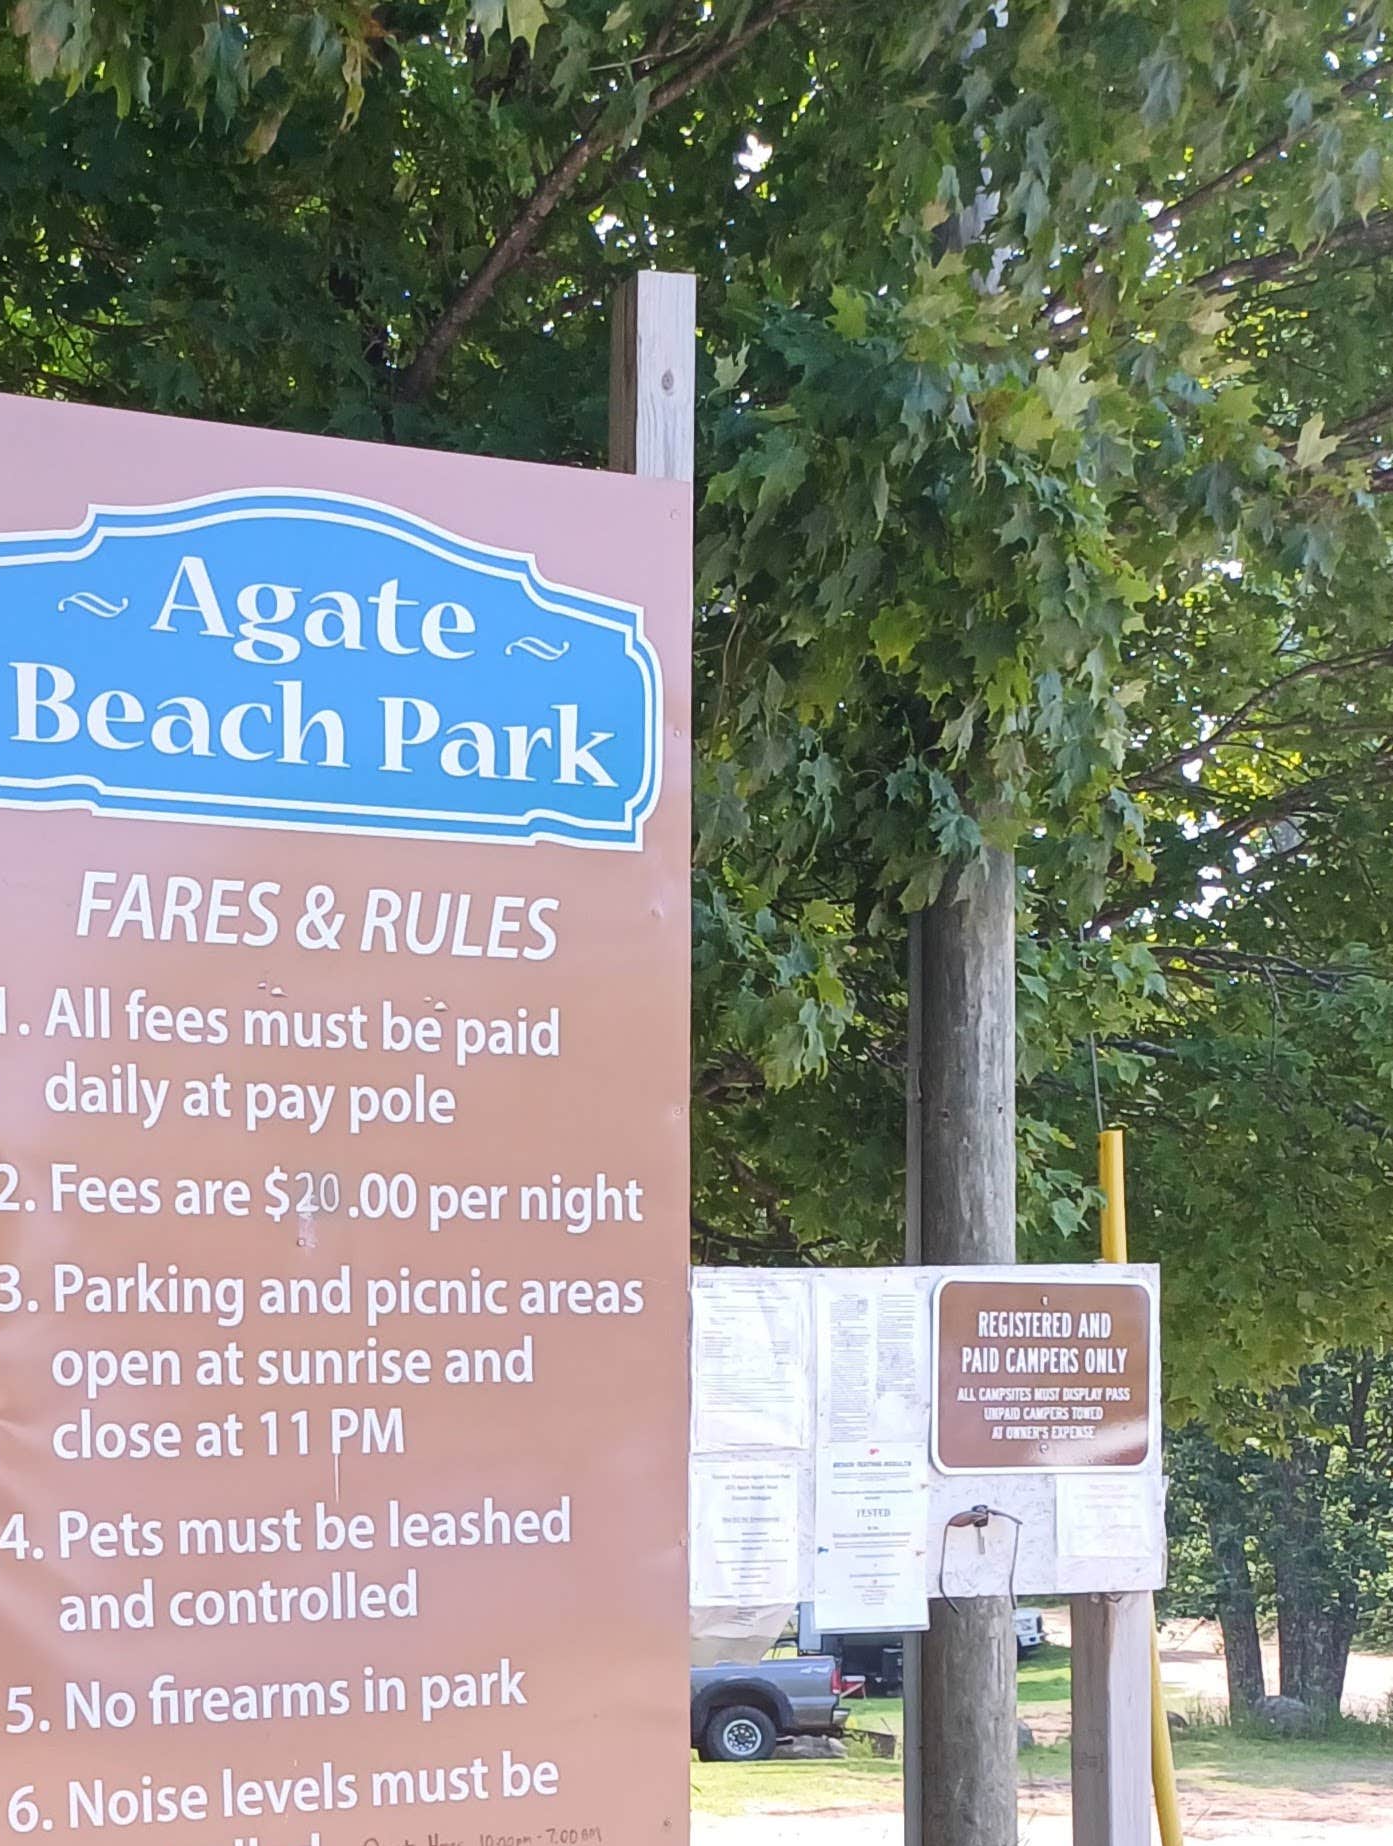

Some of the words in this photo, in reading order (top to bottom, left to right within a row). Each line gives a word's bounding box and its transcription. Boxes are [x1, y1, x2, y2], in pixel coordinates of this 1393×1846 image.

[153, 555, 476, 661] Agate
[9, 662, 350, 768] Beach
[378, 696, 618, 787] Park
[76, 871, 281, 947] FARES
[295, 884, 343, 950] &
[360, 888, 560, 961] RULES
[44, 987, 110, 1039] All
[124, 988, 228, 1044] fees
[244, 1005, 368, 1050] must
[382, 1000, 444, 1053] be
[456, 1007, 559, 1066] paid
[45, 1060, 170, 1129] daily
[183, 1073, 232, 1118] at
[246, 1083, 336, 1134] pay
[349, 1073, 456, 1134] pole
[51, 1163, 161, 1214] Fees
[174, 1179, 251, 1216] are
[429, 1185, 508, 1232] per
[520, 1173, 644, 1234] night
[54, 1262, 244, 1327] Parking
[259, 1265, 351, 1314] and
[367, 1267, 508, 1327] picnic
[519, 1280, 644, 1314] areas
[978, 1311, 1072, 1338] REGISTERED
[1077, 1312, 1112, 1339] AND
[52, 1350, 181, 1399] open
[196, 1342, 244, 1386] at
[257, 1338, 432, 1385] sunrise
[444, 1335, 534, 1384] and
[961, 1346, 1000, 1373] PAID
[1005, 1347, 1079, 1374] CAMPERS
[1084, 1347, 1128, 1374] ONLY
[1062, 1387, 1103, 1402] DISPLAY
[1105, 1387, 1131, 1401] PASS
[52, 1408, 182, 1460] close
[195, 1413, 244, 1457] at
[260, 1410, 308, 1456] 11
[331, 1407, 404, 1456] PM
[59, 1510, 164, 1559] Pets
[178, 1508, 302, 1555] must
[315, 1502, 375, 1551] be
[389, 1495, 571, 1548] leashed
[59, 1578, 154, 1632] and
[169, 1568, 418, 1627] controlled
[6, 1686, 50, 1734] 5.
[65, 1681, 136, 1730] No
[148, 1674, 350, 1725] firearms
[363, 1666, 406, 1713] in
[421, 1658, 528, 1722] park
[8, 1785, 53, 1833] 6.
[68, 1775, 208, 1829] Noise
[222, 1762, 358, 1817] levels
[372, 1757, 489, 1806] must
[502, 1750, 559, 1797] be
